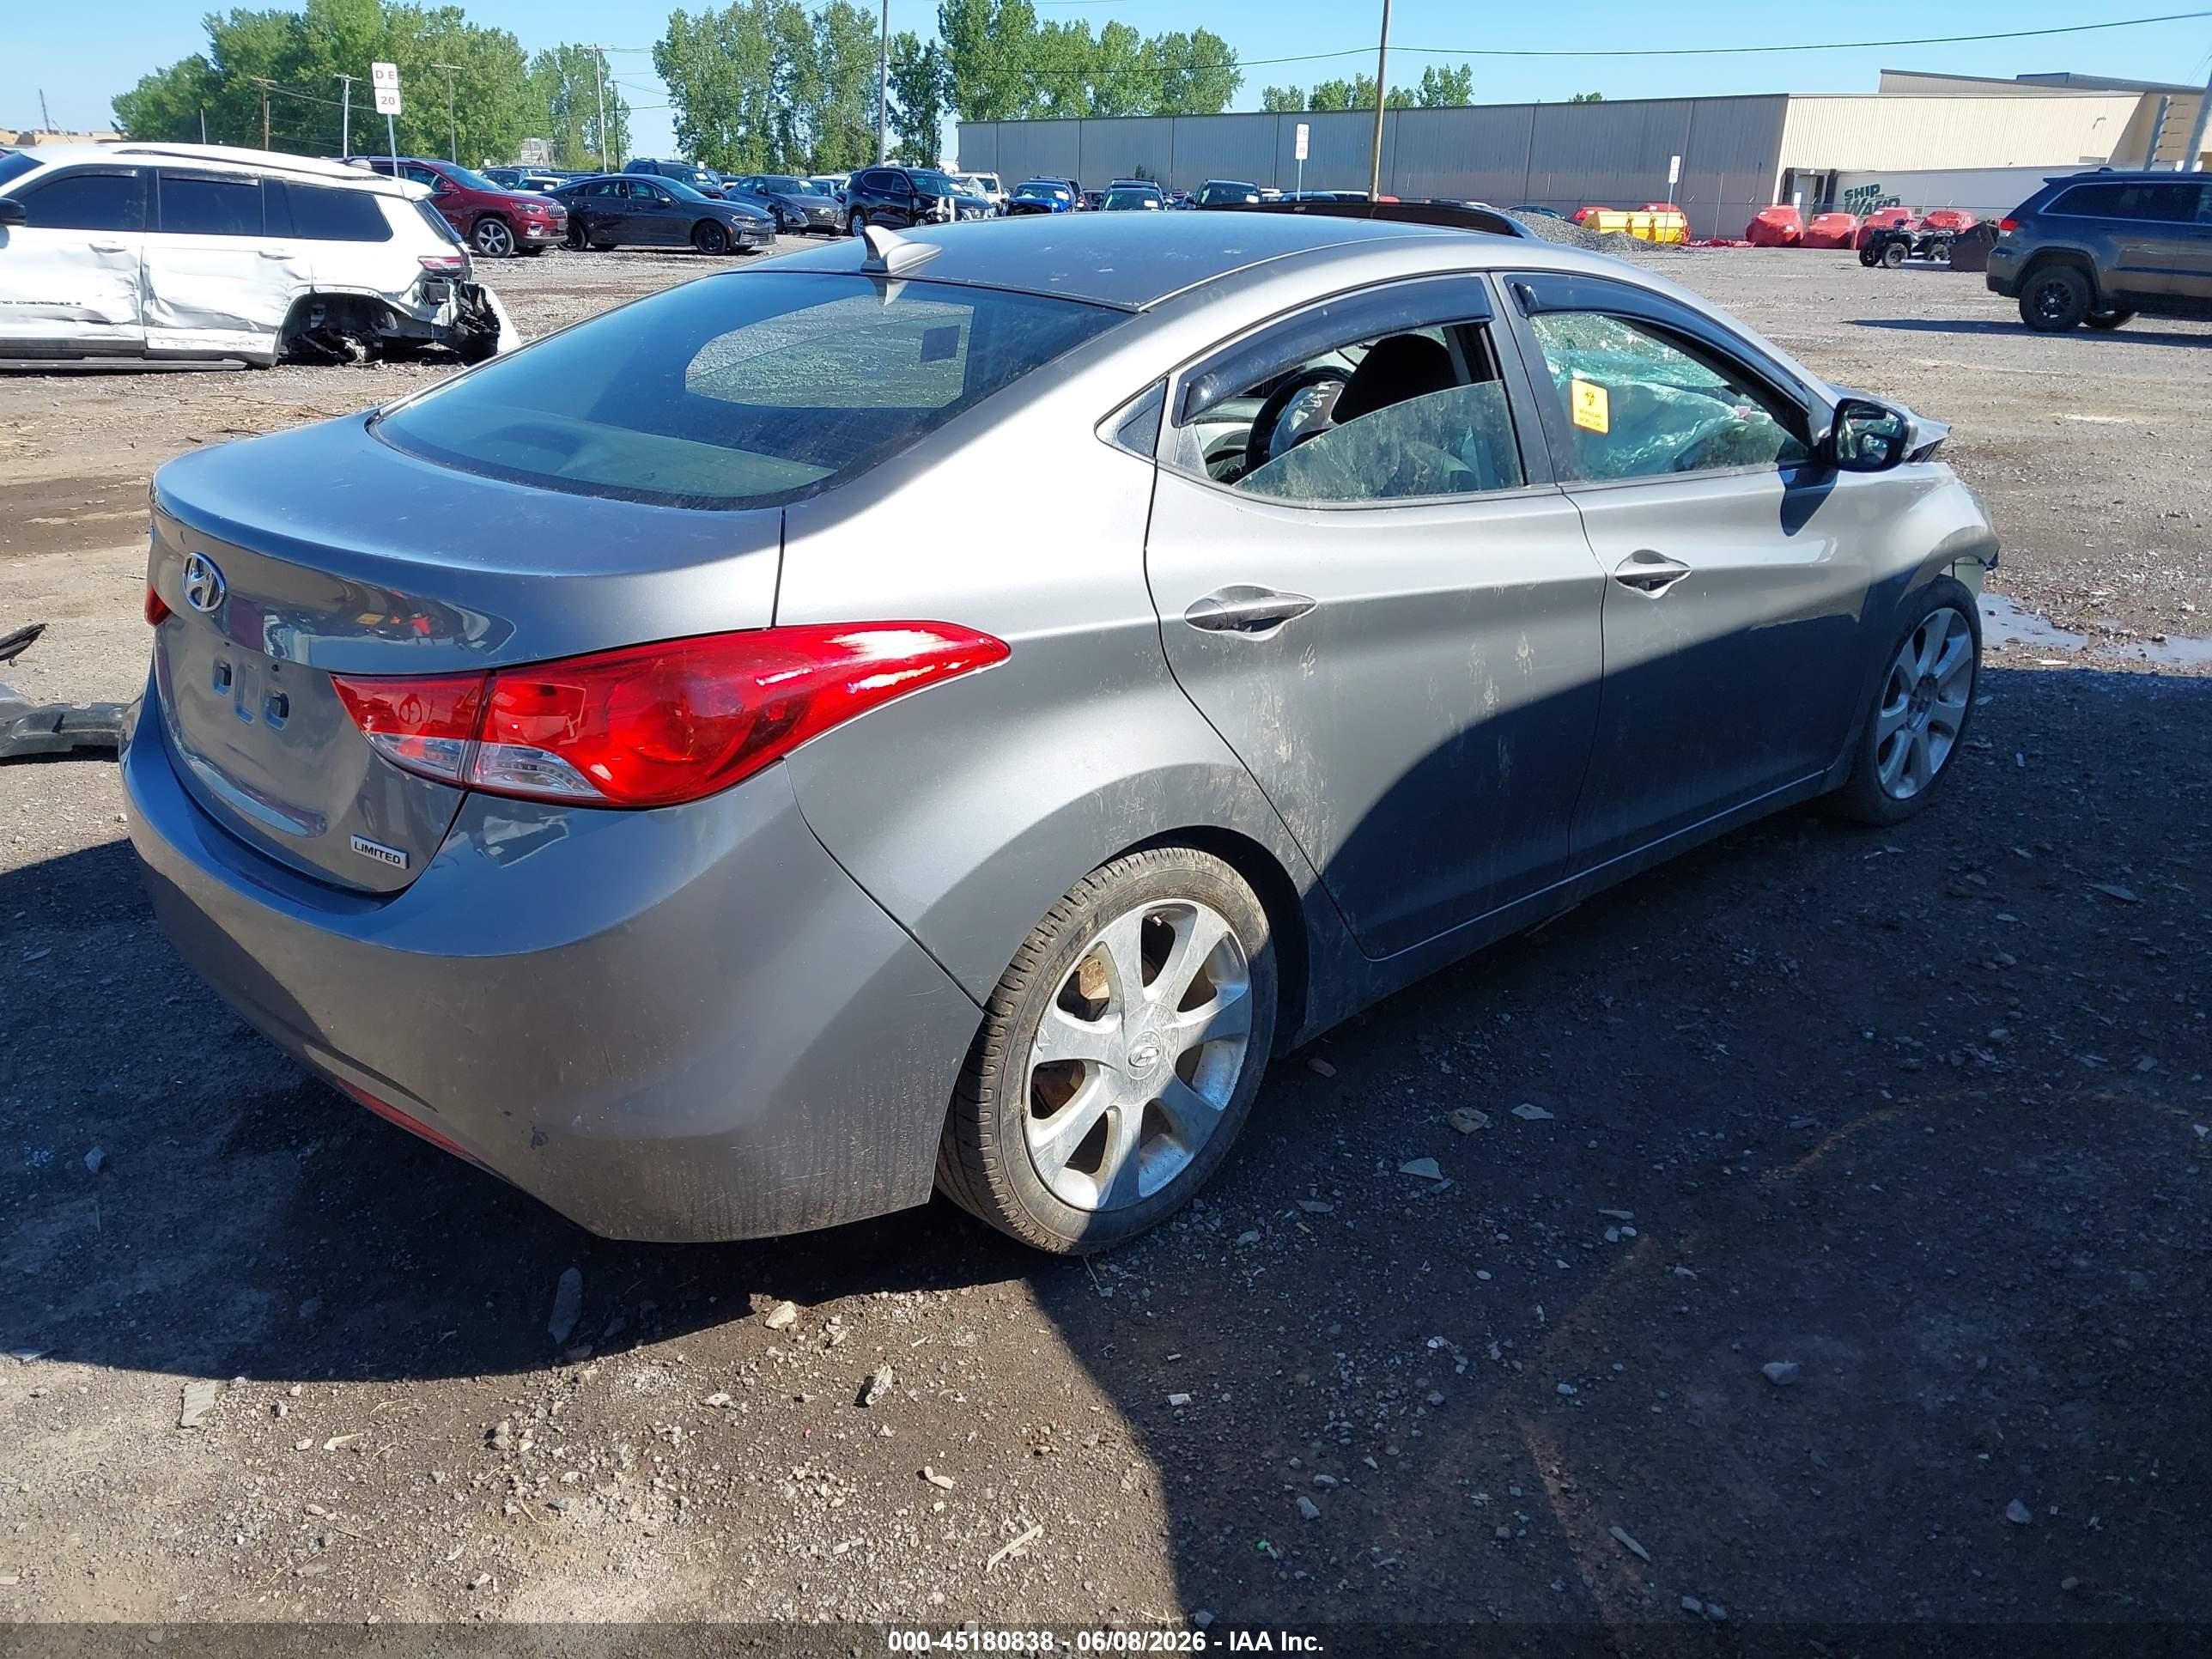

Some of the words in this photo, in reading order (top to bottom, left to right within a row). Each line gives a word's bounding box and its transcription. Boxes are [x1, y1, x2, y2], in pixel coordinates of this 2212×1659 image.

[375, 70, 384, 79] D
[388, 70, 395, 80] E
[380, 96, 395, 105] 20
[1844, 183, 1881, 201] SHIP
[354, 841, 401, 865] LIMITED
